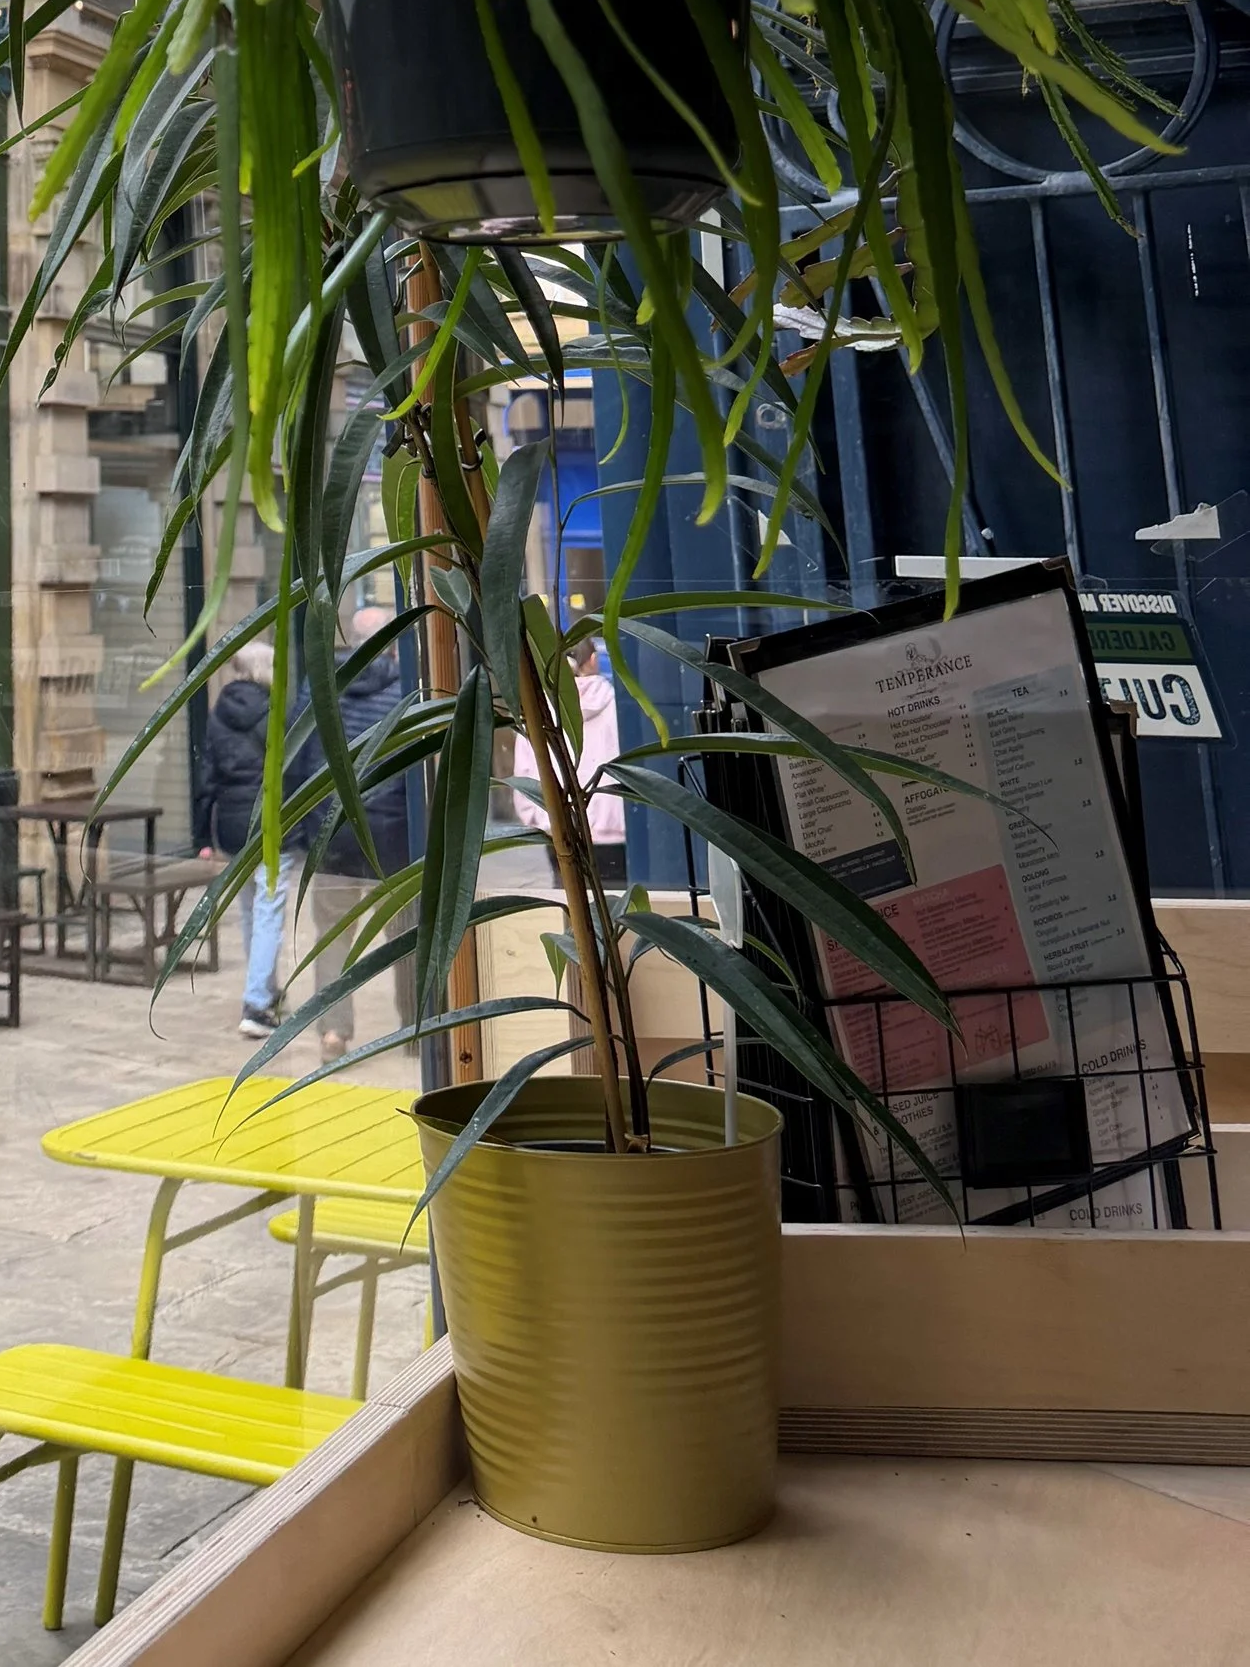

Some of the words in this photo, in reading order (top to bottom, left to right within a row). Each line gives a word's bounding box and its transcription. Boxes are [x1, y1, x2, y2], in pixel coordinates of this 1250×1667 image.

[875, 654, 974, 694] TEMPERANCE
[1011, 686, 1029, 697] TEA
[888, 705, 906, 718] HOT
[908, 695, 941, 712] DRINKS
[987, 707, 1009, 719] BLACK
[1022, 868, 1049, 883] OOLONG
[1081, 1054, 1108, 1074] COLD
[1104, 1202, 1143, 1218] DRINKS
